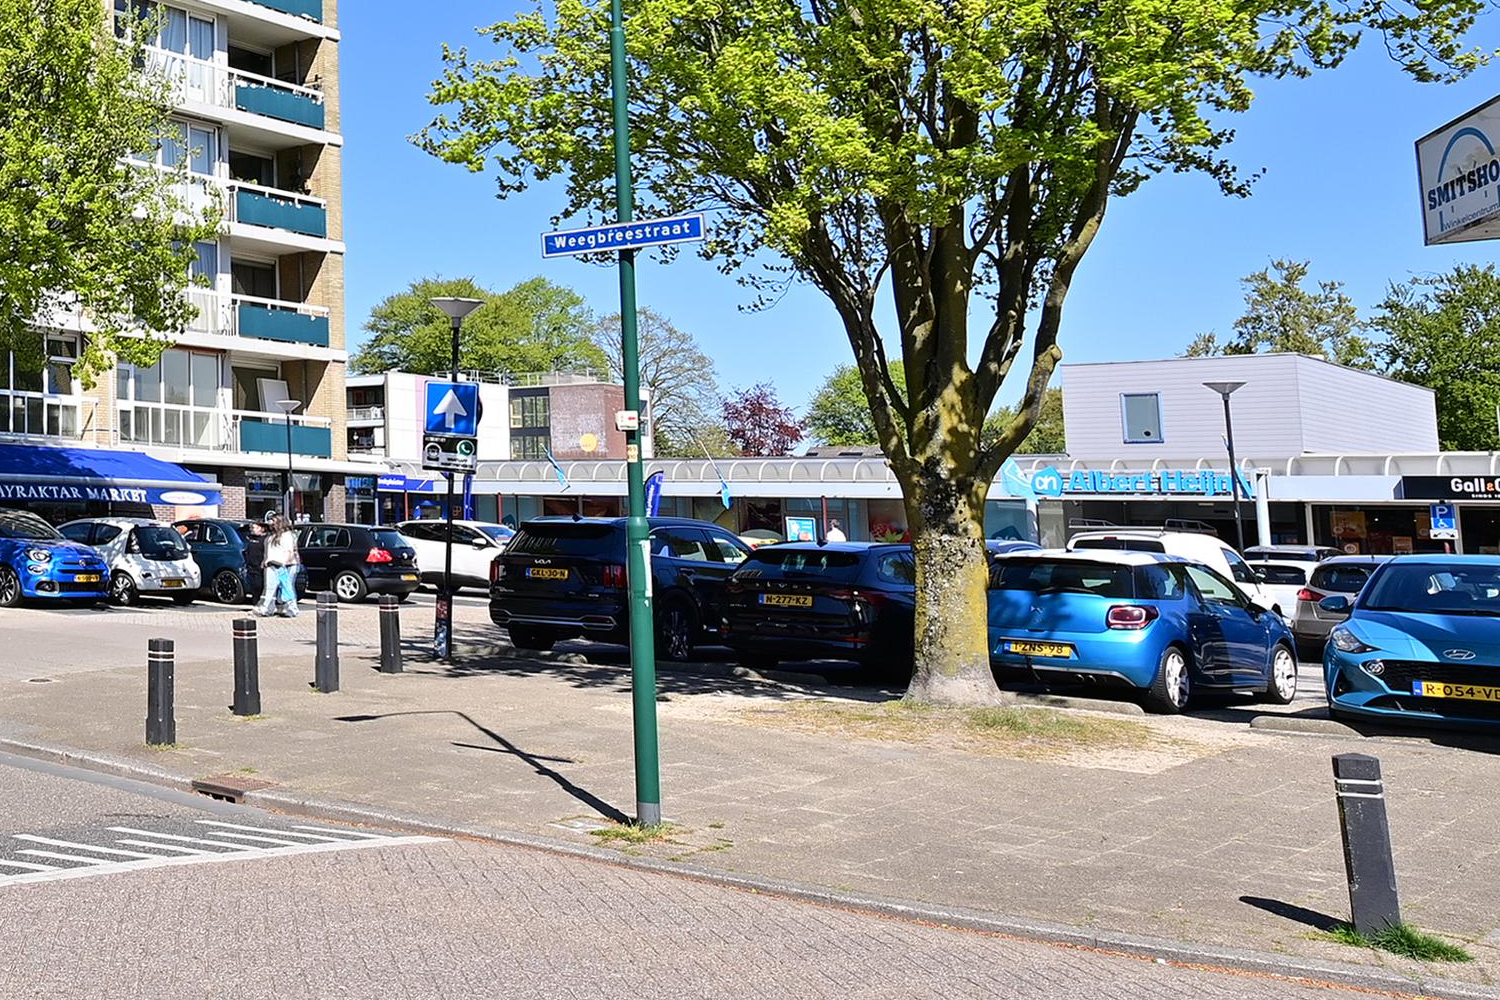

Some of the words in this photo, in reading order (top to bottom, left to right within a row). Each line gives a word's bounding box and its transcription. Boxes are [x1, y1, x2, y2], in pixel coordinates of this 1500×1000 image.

[1443, 201, 1499, 231] Winkelcentrum
[554, 220, 691, 250] Weegbreestraat
[85, 486, 147, 503] MARKET
[1068, 470, 1158, 493] Albert
[1160, 470, 1234, 496] Heijn
